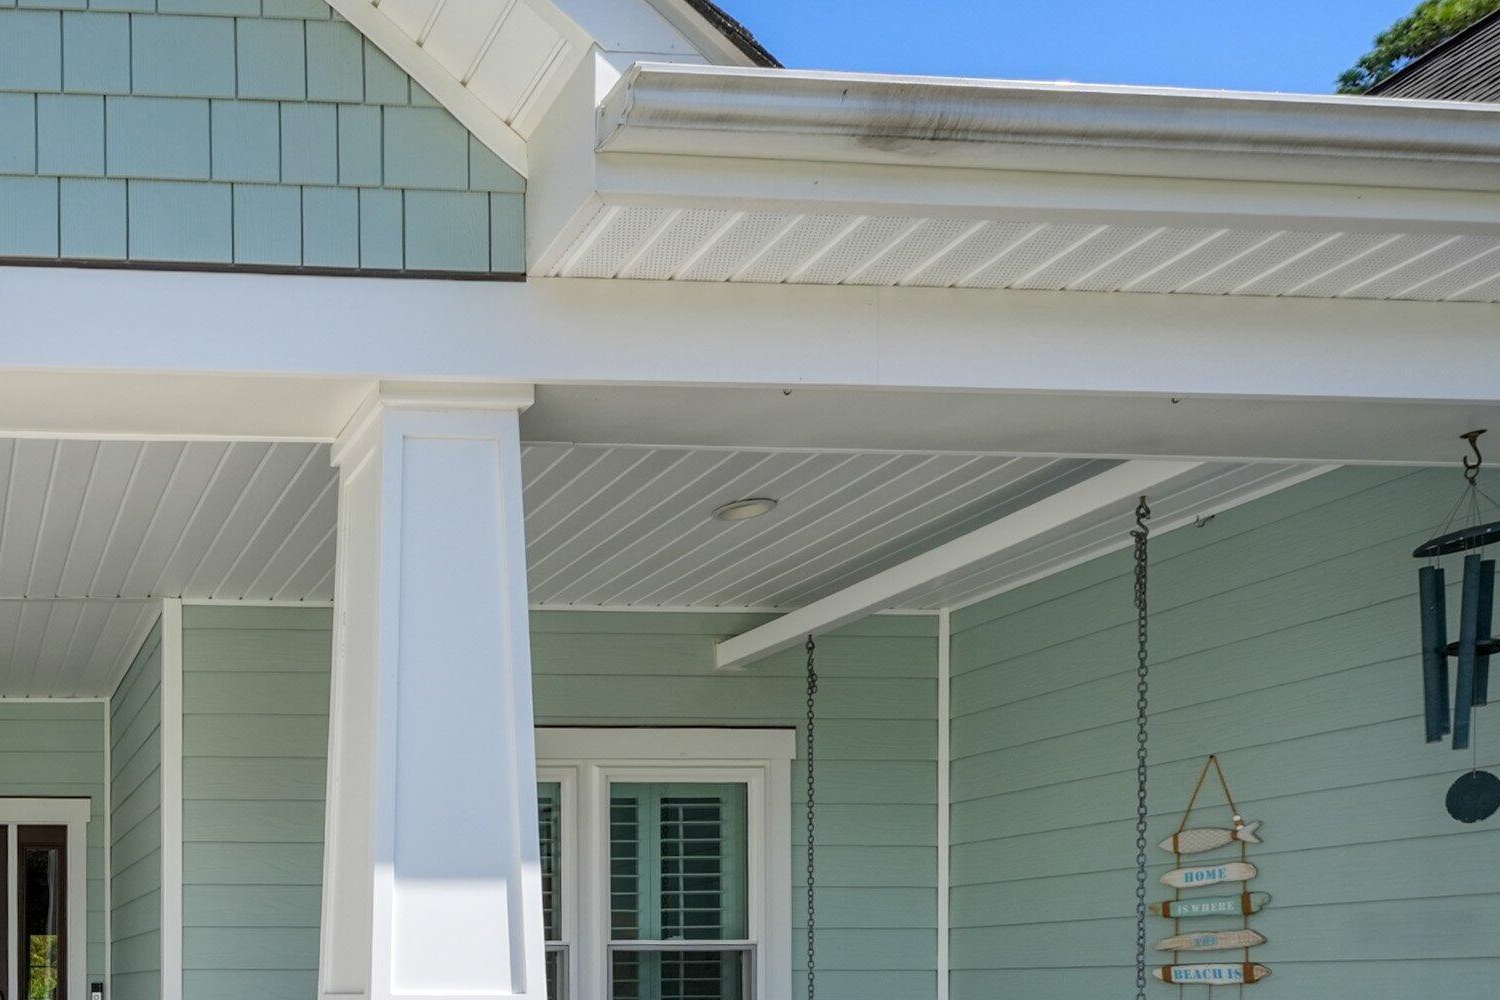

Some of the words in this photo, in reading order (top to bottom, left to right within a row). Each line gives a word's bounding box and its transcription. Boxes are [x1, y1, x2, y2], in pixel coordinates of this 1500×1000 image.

[1183, 867, 1227, 883] HOME
[1177, 905, 1189, 915] IS
[1190, 901, 1235, 913] WHERE
[1173, 968, 1222, 980] BEACH
[1227, 968, 1243, 980] IS
